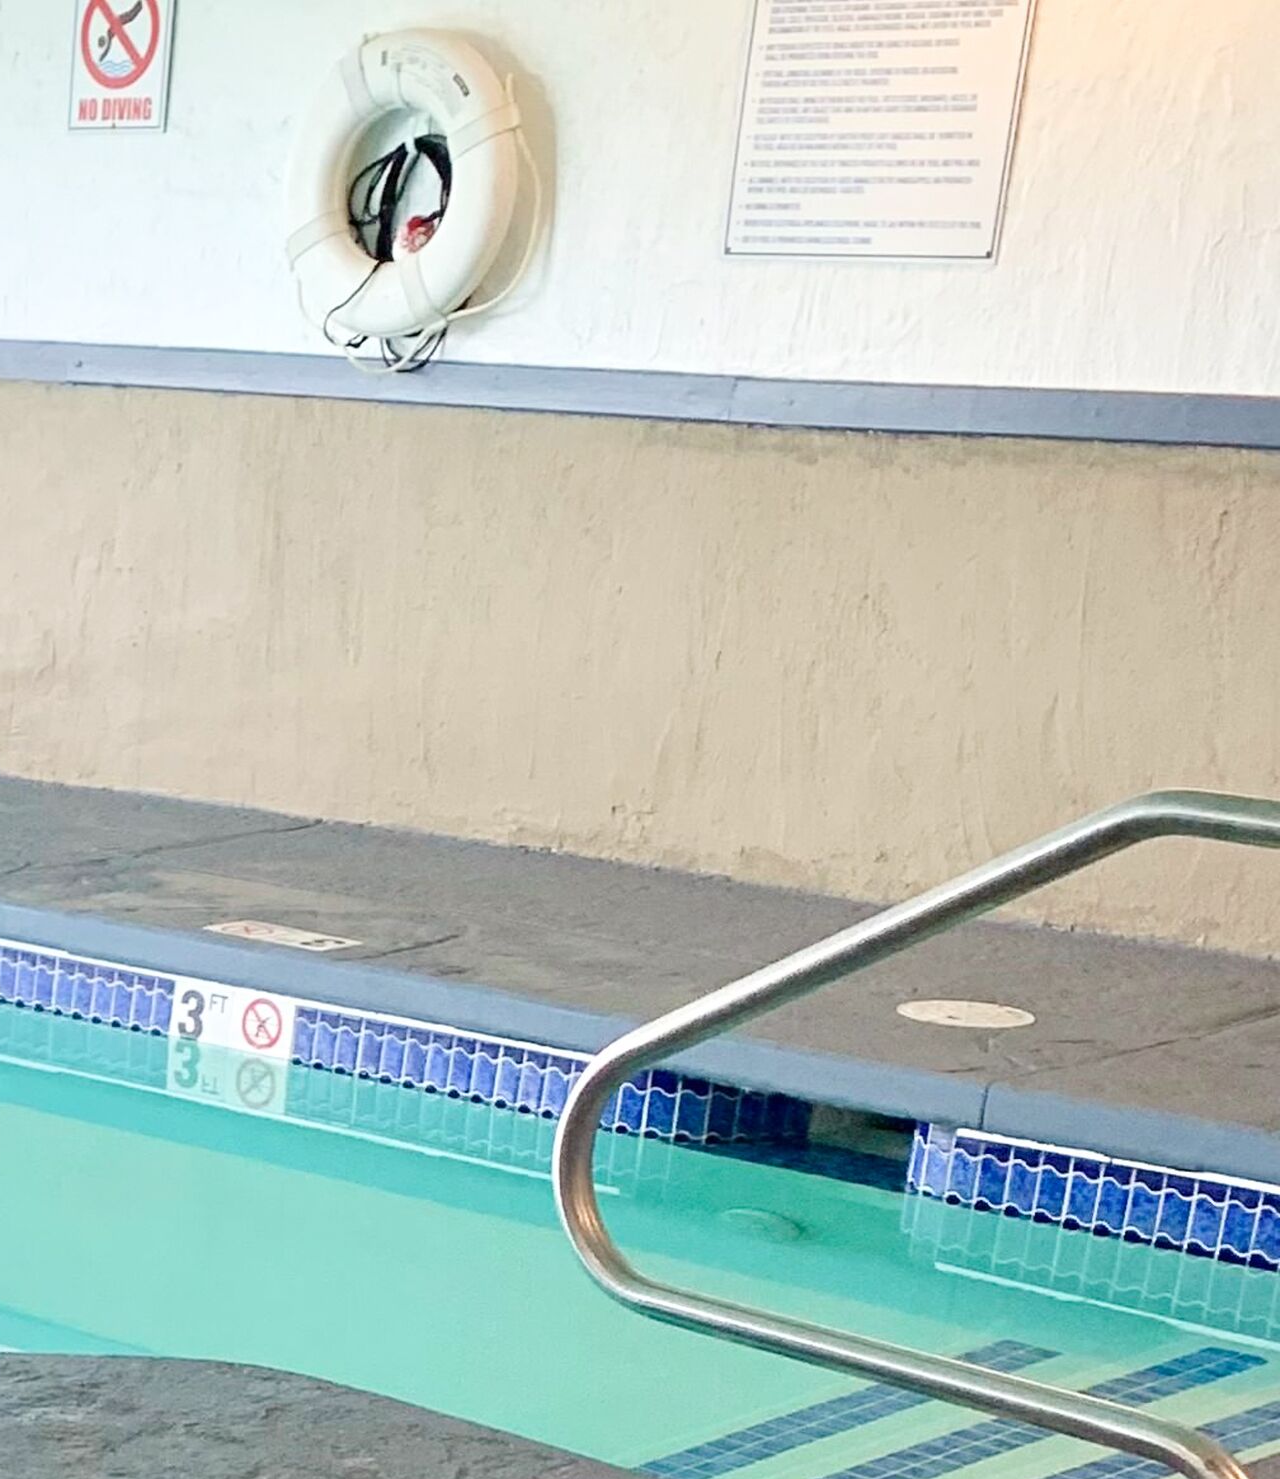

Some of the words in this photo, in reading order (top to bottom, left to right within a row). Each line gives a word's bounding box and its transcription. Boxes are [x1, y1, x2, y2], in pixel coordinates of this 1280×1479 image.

[78, 98, 98, 121] NO
[101, 97, 153, 121] DIVING
[177, 989, 205, 1041] 3
[209, 993, 229, 1014] FT
